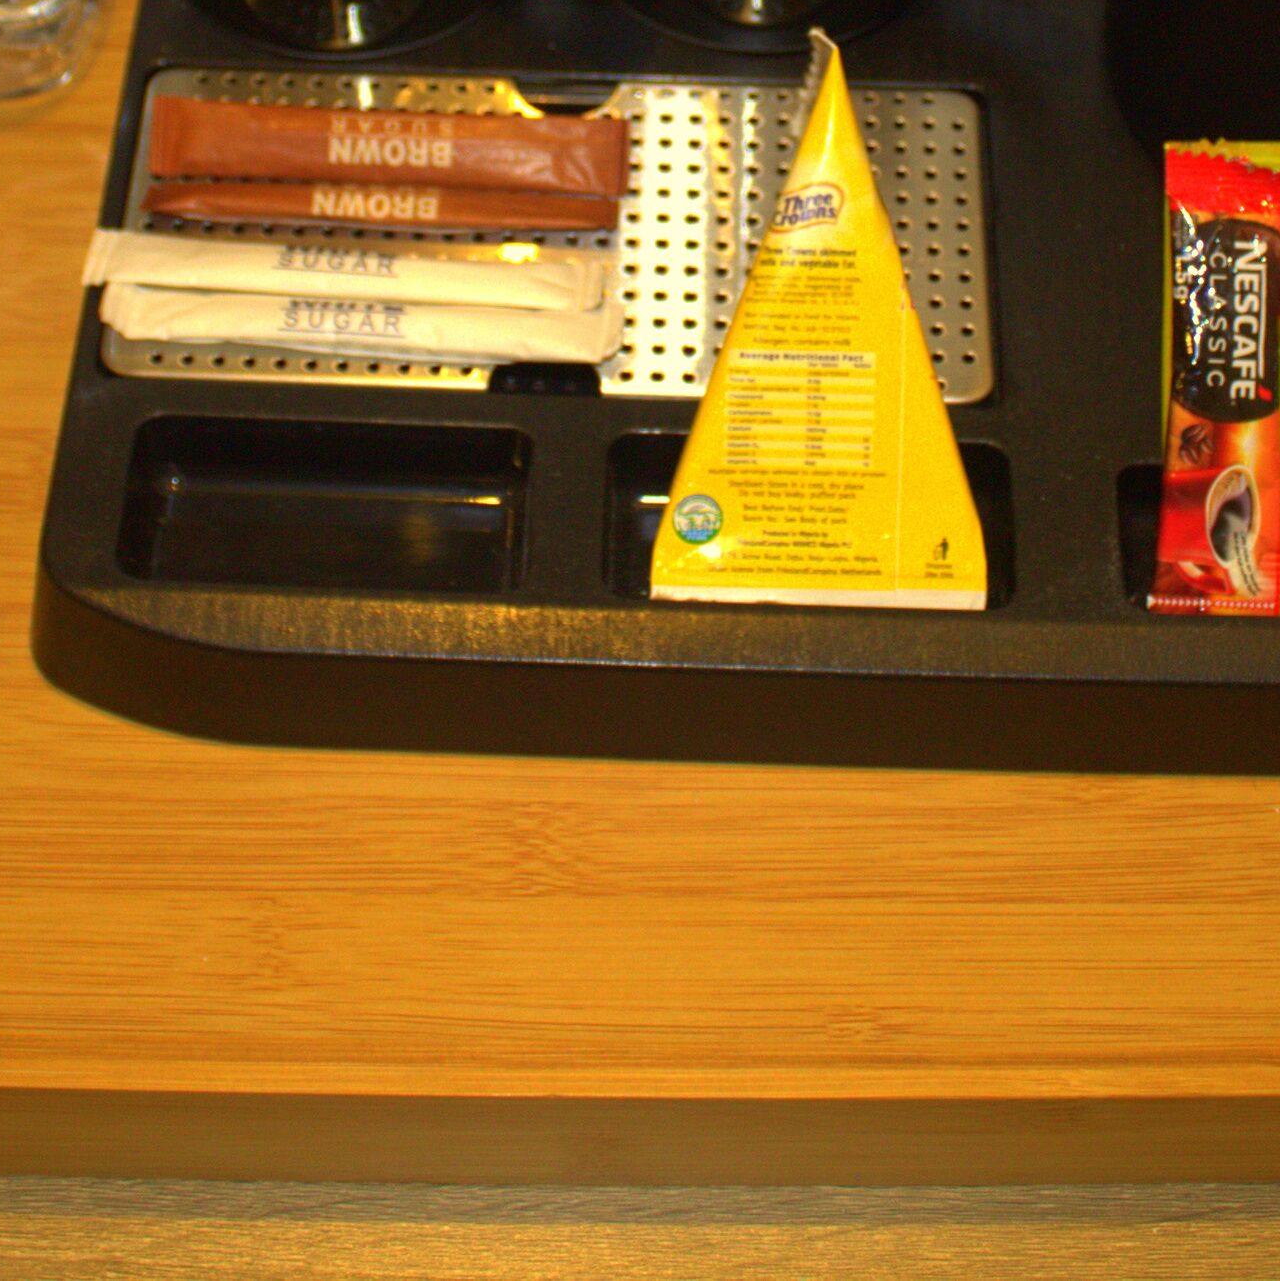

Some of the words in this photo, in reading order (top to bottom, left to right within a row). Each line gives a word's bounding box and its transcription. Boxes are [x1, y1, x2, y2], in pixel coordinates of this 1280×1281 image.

[331, 115, 453, 137] SUGAR
[328, 137, 453, 168] BROWN
[311, 189, 439, 220] BROWN
[784, 193, 833, 214] Three
[277, 250, 395, 274] SUGAR
[283, 310, 400, 334] SUGAR
[1206, 251, 1228, 387] CLASSIC
